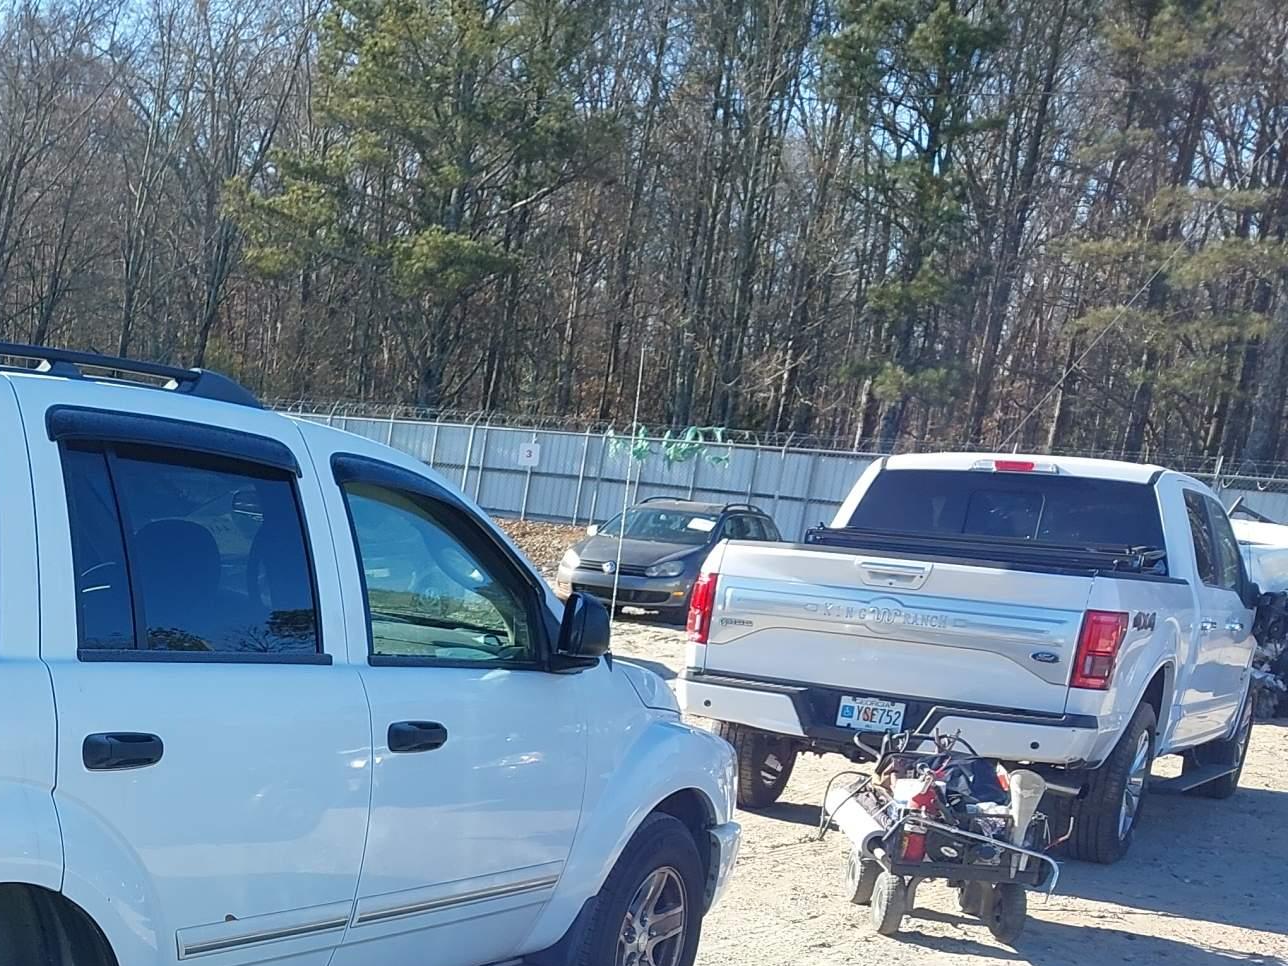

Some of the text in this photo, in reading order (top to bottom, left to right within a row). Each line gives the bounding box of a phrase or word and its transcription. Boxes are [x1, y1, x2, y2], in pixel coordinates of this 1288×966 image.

[525, 449, 533, 458] 3
[823, 602, 948, 629] KING RANCH
[856, 705, 902, 726] YSE752
